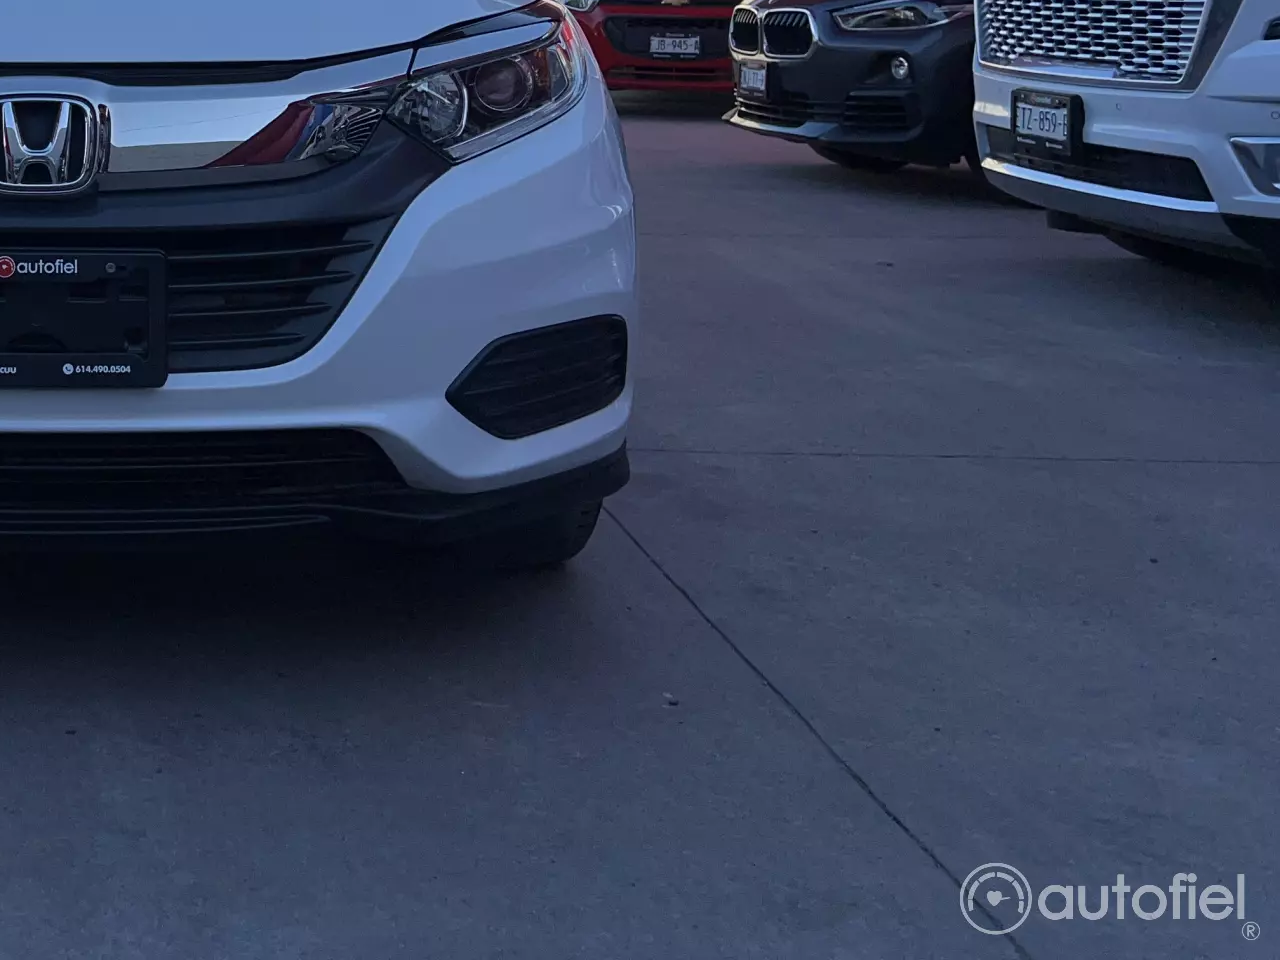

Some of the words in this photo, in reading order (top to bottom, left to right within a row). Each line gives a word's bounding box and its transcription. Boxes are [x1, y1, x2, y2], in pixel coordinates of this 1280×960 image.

[1016, 107, 1068, 137] TZ-859-
[16, 259, 78, 274] autofiel
[75, 365, 131, 373] 614.490.0504
